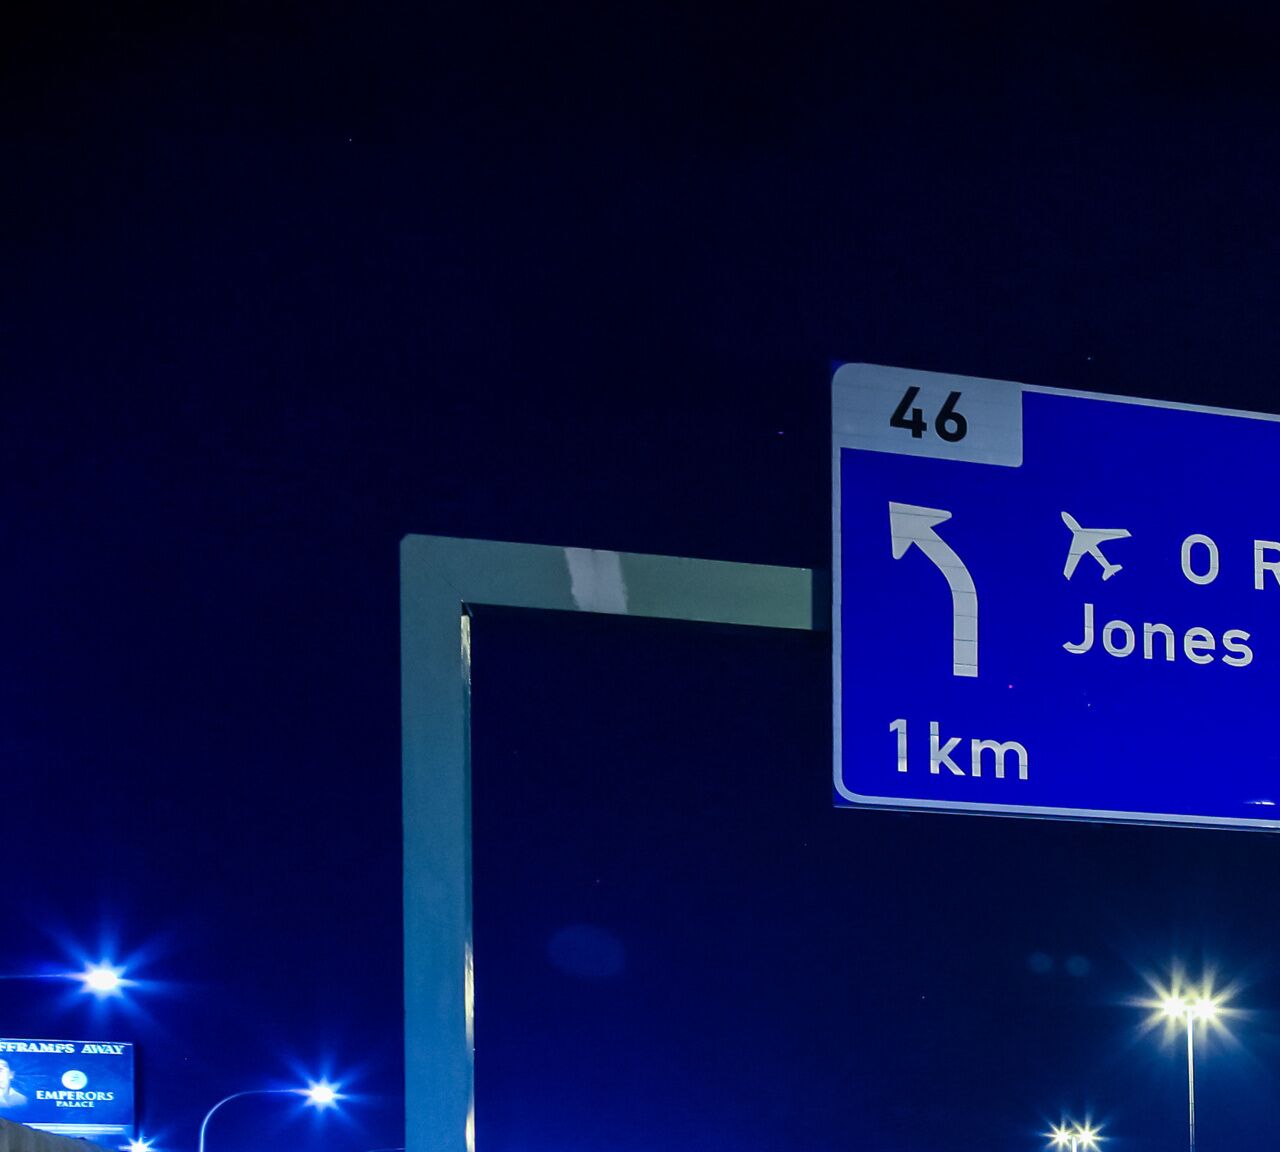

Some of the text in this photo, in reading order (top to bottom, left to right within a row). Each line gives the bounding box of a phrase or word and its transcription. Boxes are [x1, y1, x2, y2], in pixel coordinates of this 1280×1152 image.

[889, 385, 968, 443] 46
[1180, 533, 1220, 586] O
[1062, 602, 1254, 667] Jones
[81, 1044, 124, 1055] AWAY
[36, 1090, 114, 1101] EMPERORS
